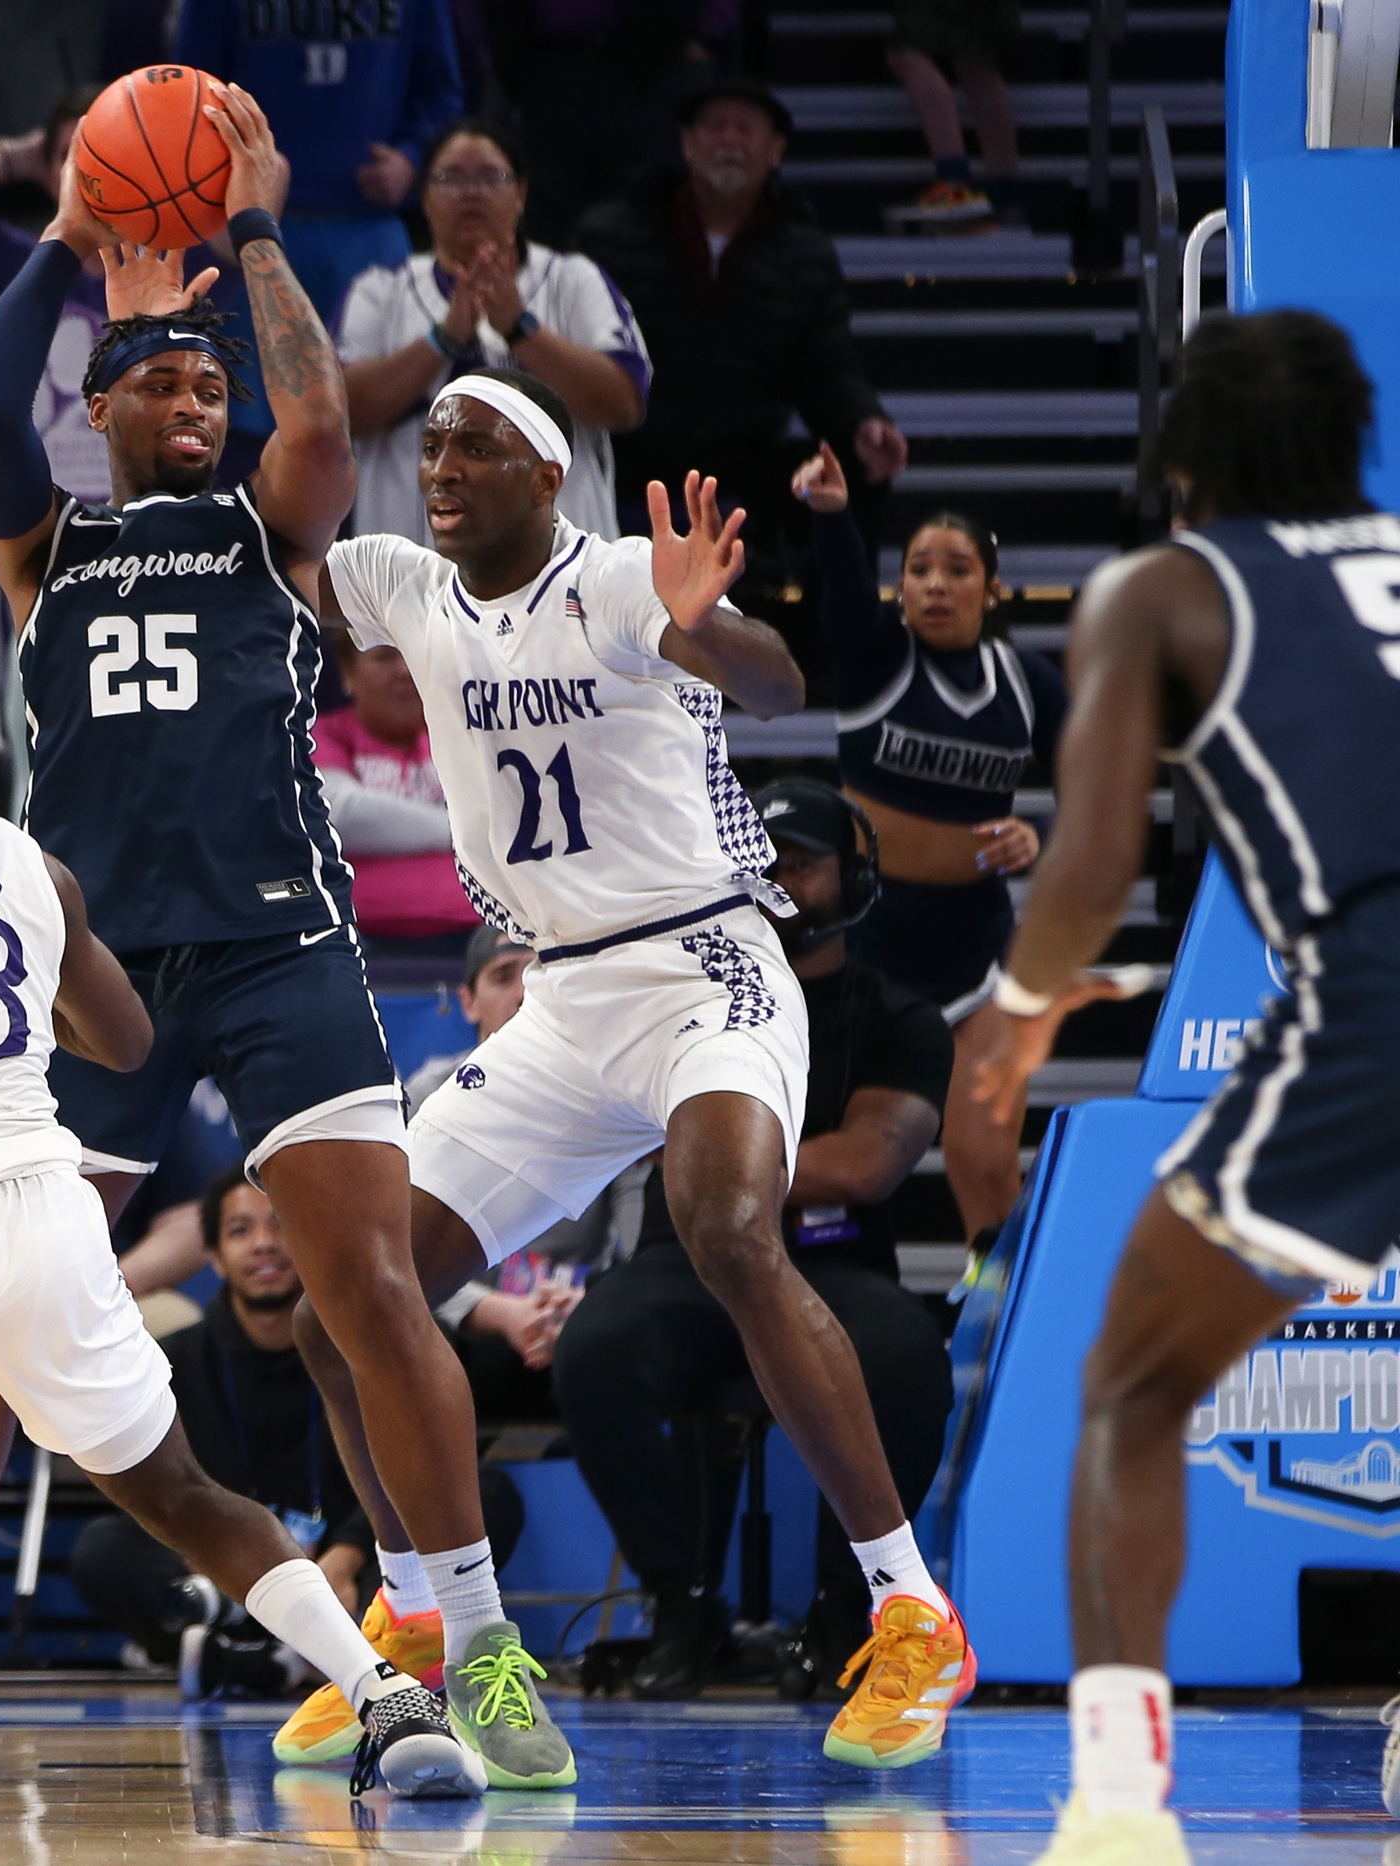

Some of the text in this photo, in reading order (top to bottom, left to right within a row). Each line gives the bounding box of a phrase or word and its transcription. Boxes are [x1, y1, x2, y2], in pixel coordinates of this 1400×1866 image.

[51, 542, 243, 598] Longwood
[87, 614, 199, 718] 25
[508, 678, 605, 730] POINT
[497, 741, 593, 865] 21
[1284, 1321, 1396, 1340] BASKET
